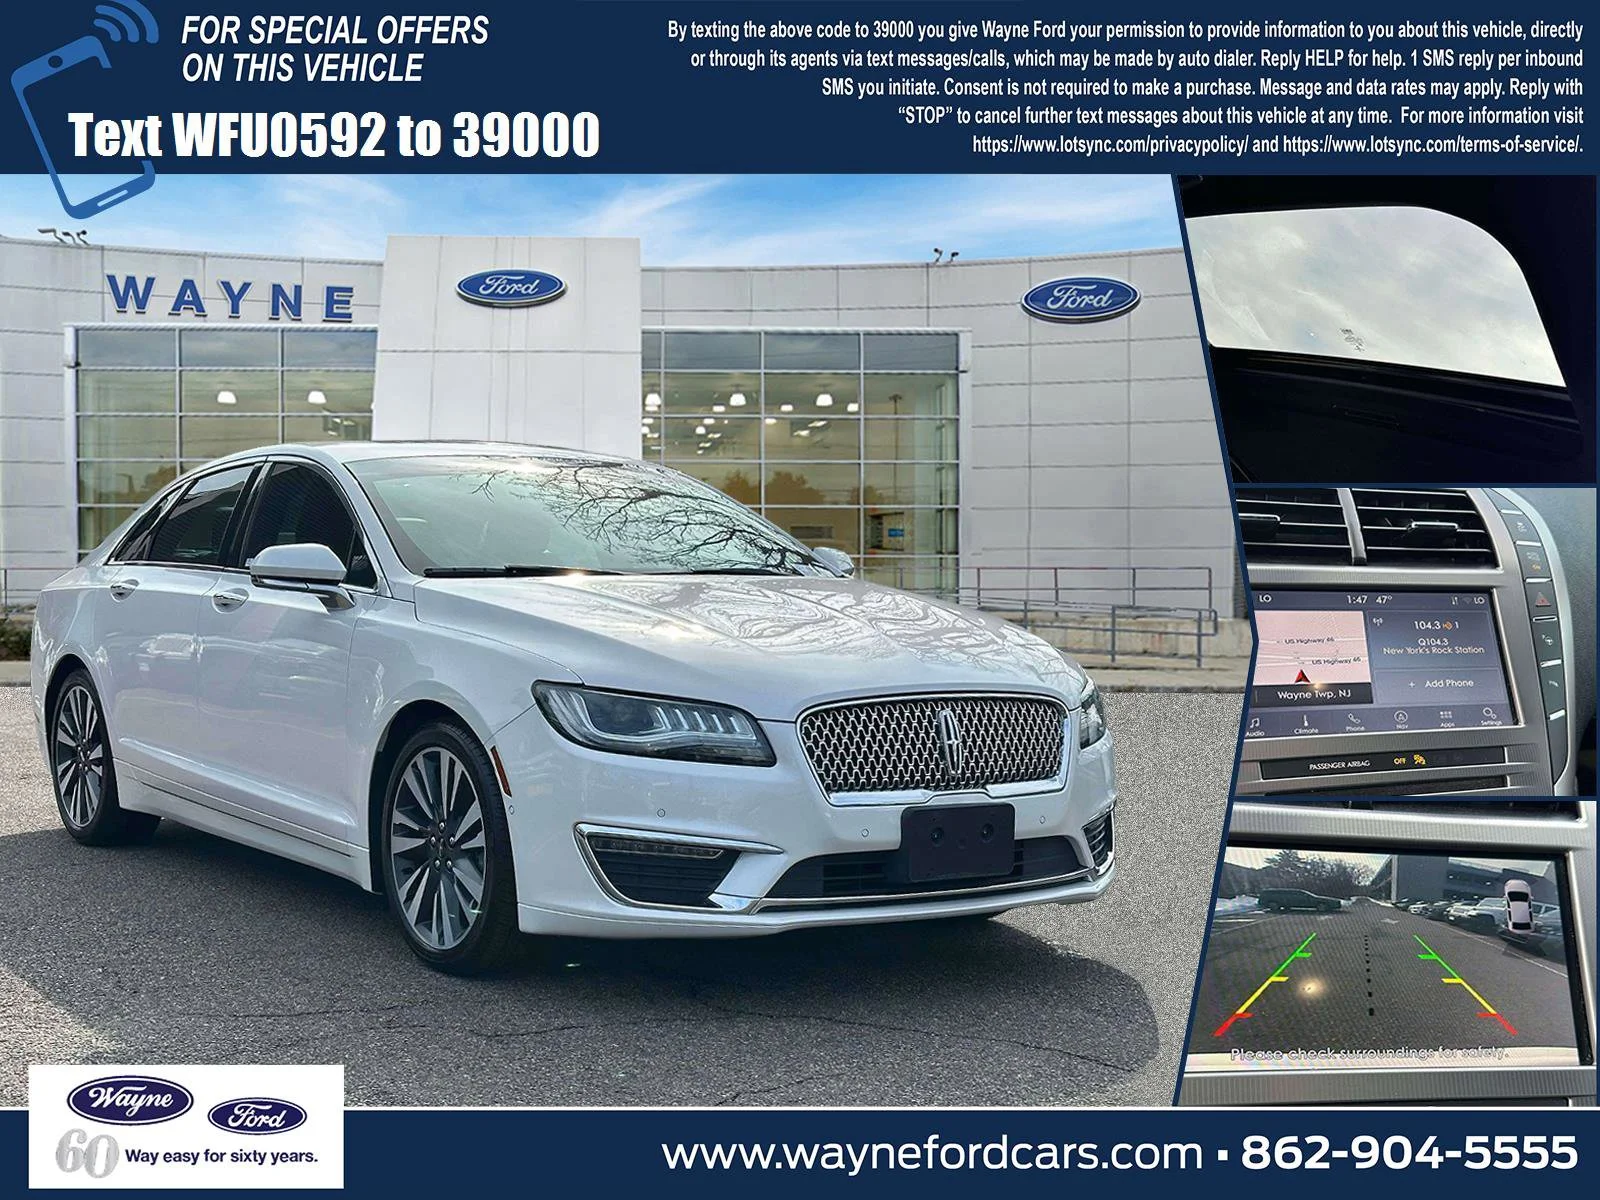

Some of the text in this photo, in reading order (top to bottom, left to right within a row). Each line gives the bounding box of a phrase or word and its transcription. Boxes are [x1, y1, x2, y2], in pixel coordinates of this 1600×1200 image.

[478, 274, 540, 296] Ford
[105, 274, 355, 322] WAYNE
[1046, 284, 1114, 309] Ford
[1259, 594, 1272, 603] LO
[1346, 595, 1368, 604] 1:47
[1473, 596, 1485, 605] LO
[1414, 621, 1441, 630] 104.3
[1418, 637, 1449, 647] Q104.3
[1383, 645, 1485, 655] New York's Rock Station
[1425, 679, 1474, 688] Add Phone
[1277, 689, 1352, 701] Wayne Twp, NJ
[1294, 727, 1319, 735] Climate
[1309, 762, 1346, 771] PASSENGER
[1347, 759, 1371, 769] AIRBAG
[1230, 1048, 1284, 1061] Please
[1287, 1047, 1336, 1060] check
[1339, 1045, 1436, 1061] surroundings
[1438, 1045, 1458, 1059] for
